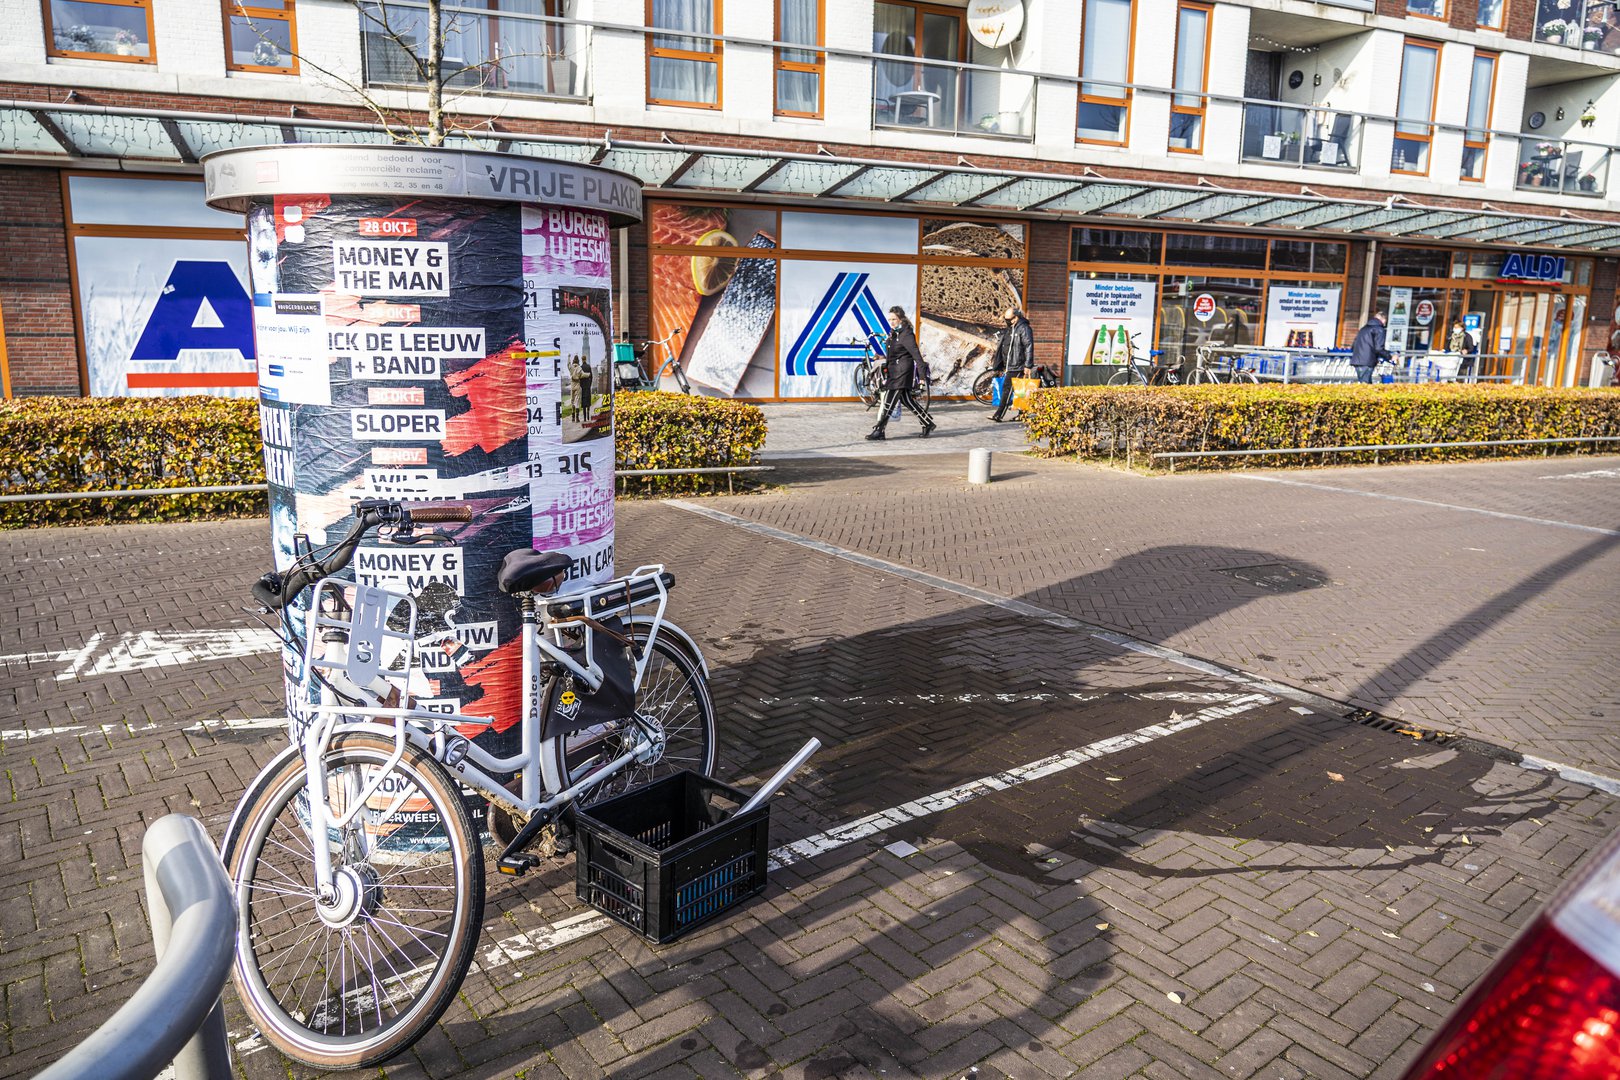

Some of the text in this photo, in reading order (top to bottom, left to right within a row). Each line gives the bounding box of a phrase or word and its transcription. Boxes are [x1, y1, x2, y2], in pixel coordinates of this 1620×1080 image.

[377, 155, 414, 163] bedoeld
[344, 165, 442, 175] commerciële reclame
[485, 165, 575, 200] VRIJE
[364, 221, 412, 233] 28 OKT.
[549, 210, 606, 238] BURGER
[339, 247, 443, 267] MONEY &
[1501, 253, 1566, 281] ALDI
[339, 270, 443, 291] THE MAN
[523, 291, 538, 308] 21
[365, 333, 393, 351] DE
[400, 334, 481, 352] LEEUW
[354, 356, 436, 375] + BAND
[389, 391, 420, 402] OKT.
[356, 413, 441, 433] SLOPER
[392, 450, 423, 462] NOV.
[528, 452, 541, 461] ZA
[525, 463, 543, 478] 13
[359, 552, 458, 572] MONEY &
[529, 675, 539, 719] Dolce
